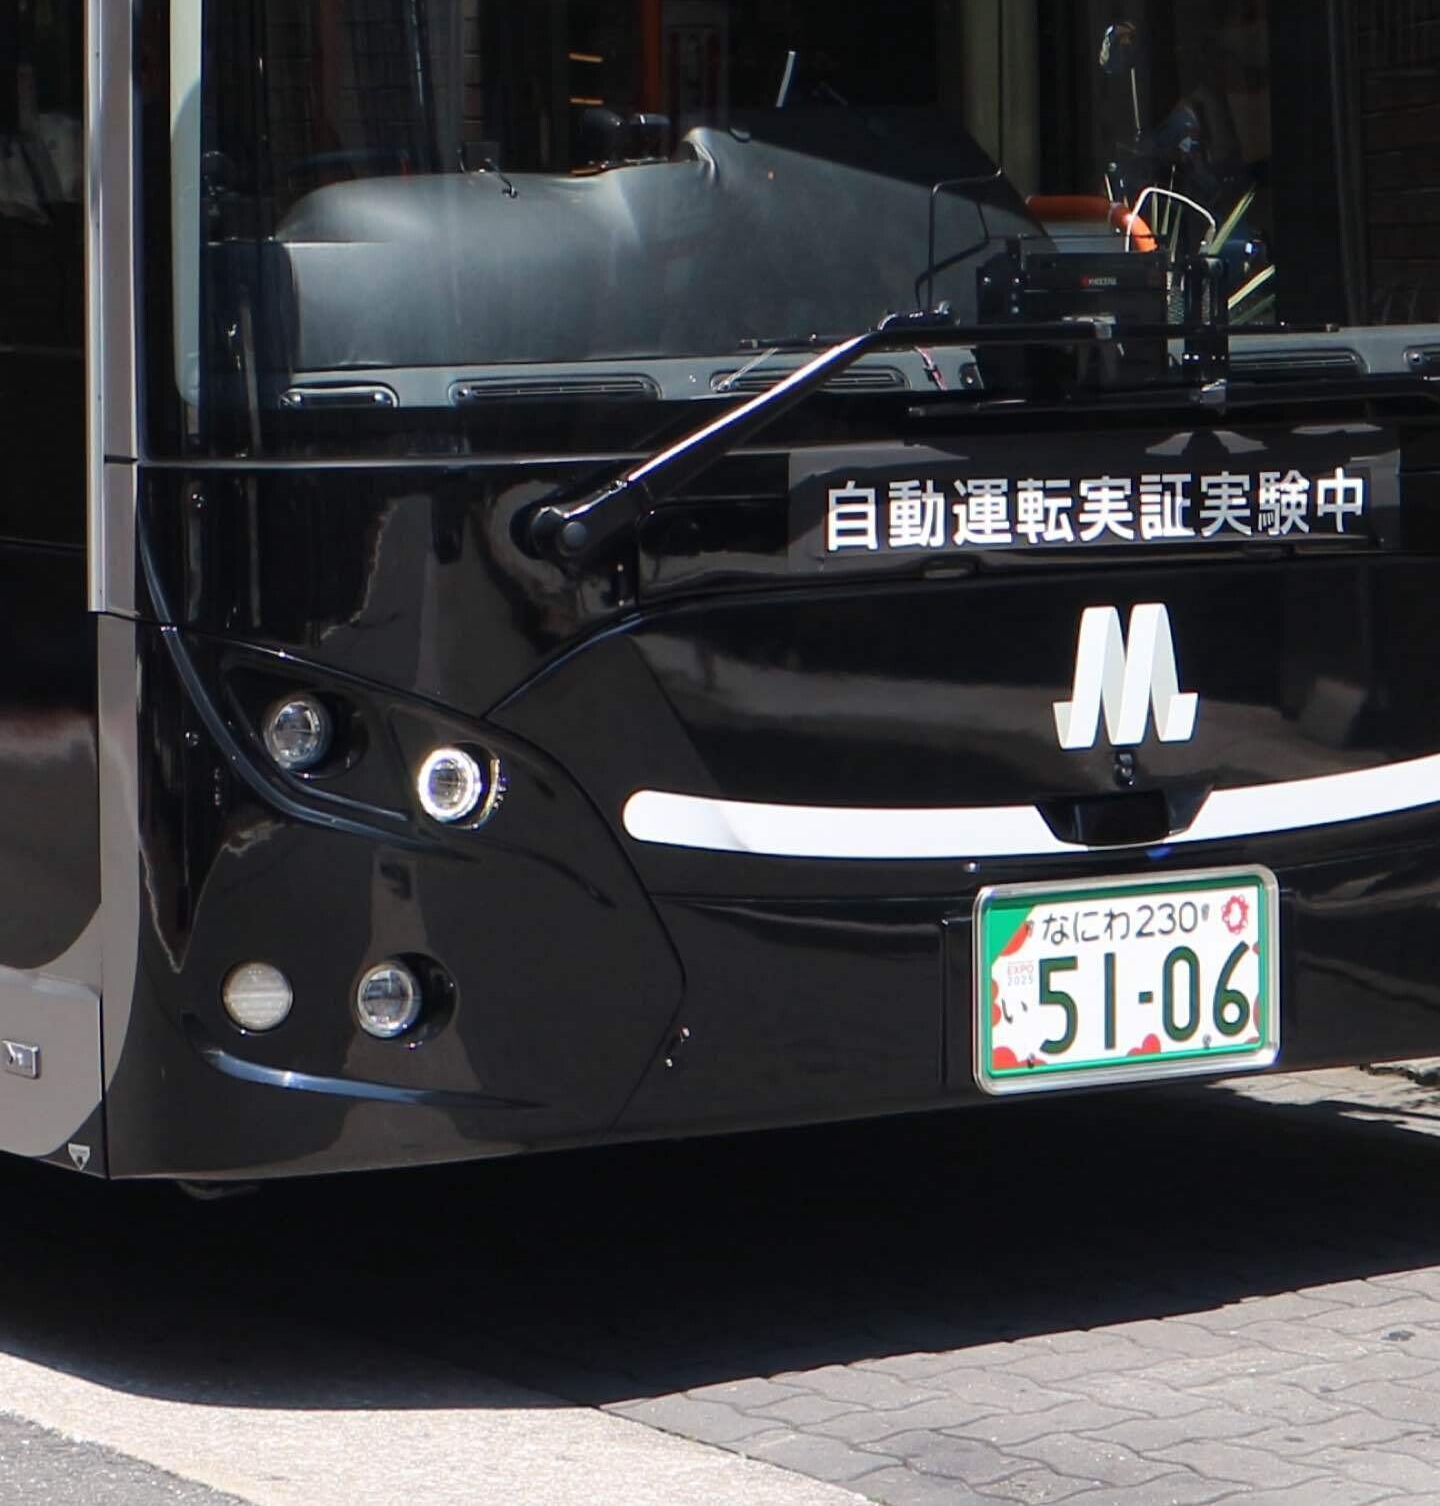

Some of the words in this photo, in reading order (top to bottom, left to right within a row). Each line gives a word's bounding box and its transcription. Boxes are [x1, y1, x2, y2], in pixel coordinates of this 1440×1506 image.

[826, 467, 1365, 551] 自動運転実証実験中
[1007, 963, 1035, 975] EXPO
[1008, 975, 1035, 987] 2025
[1001, 998, 1029, 1025] い
[1039, 940, 1250, 1056] 51-06
